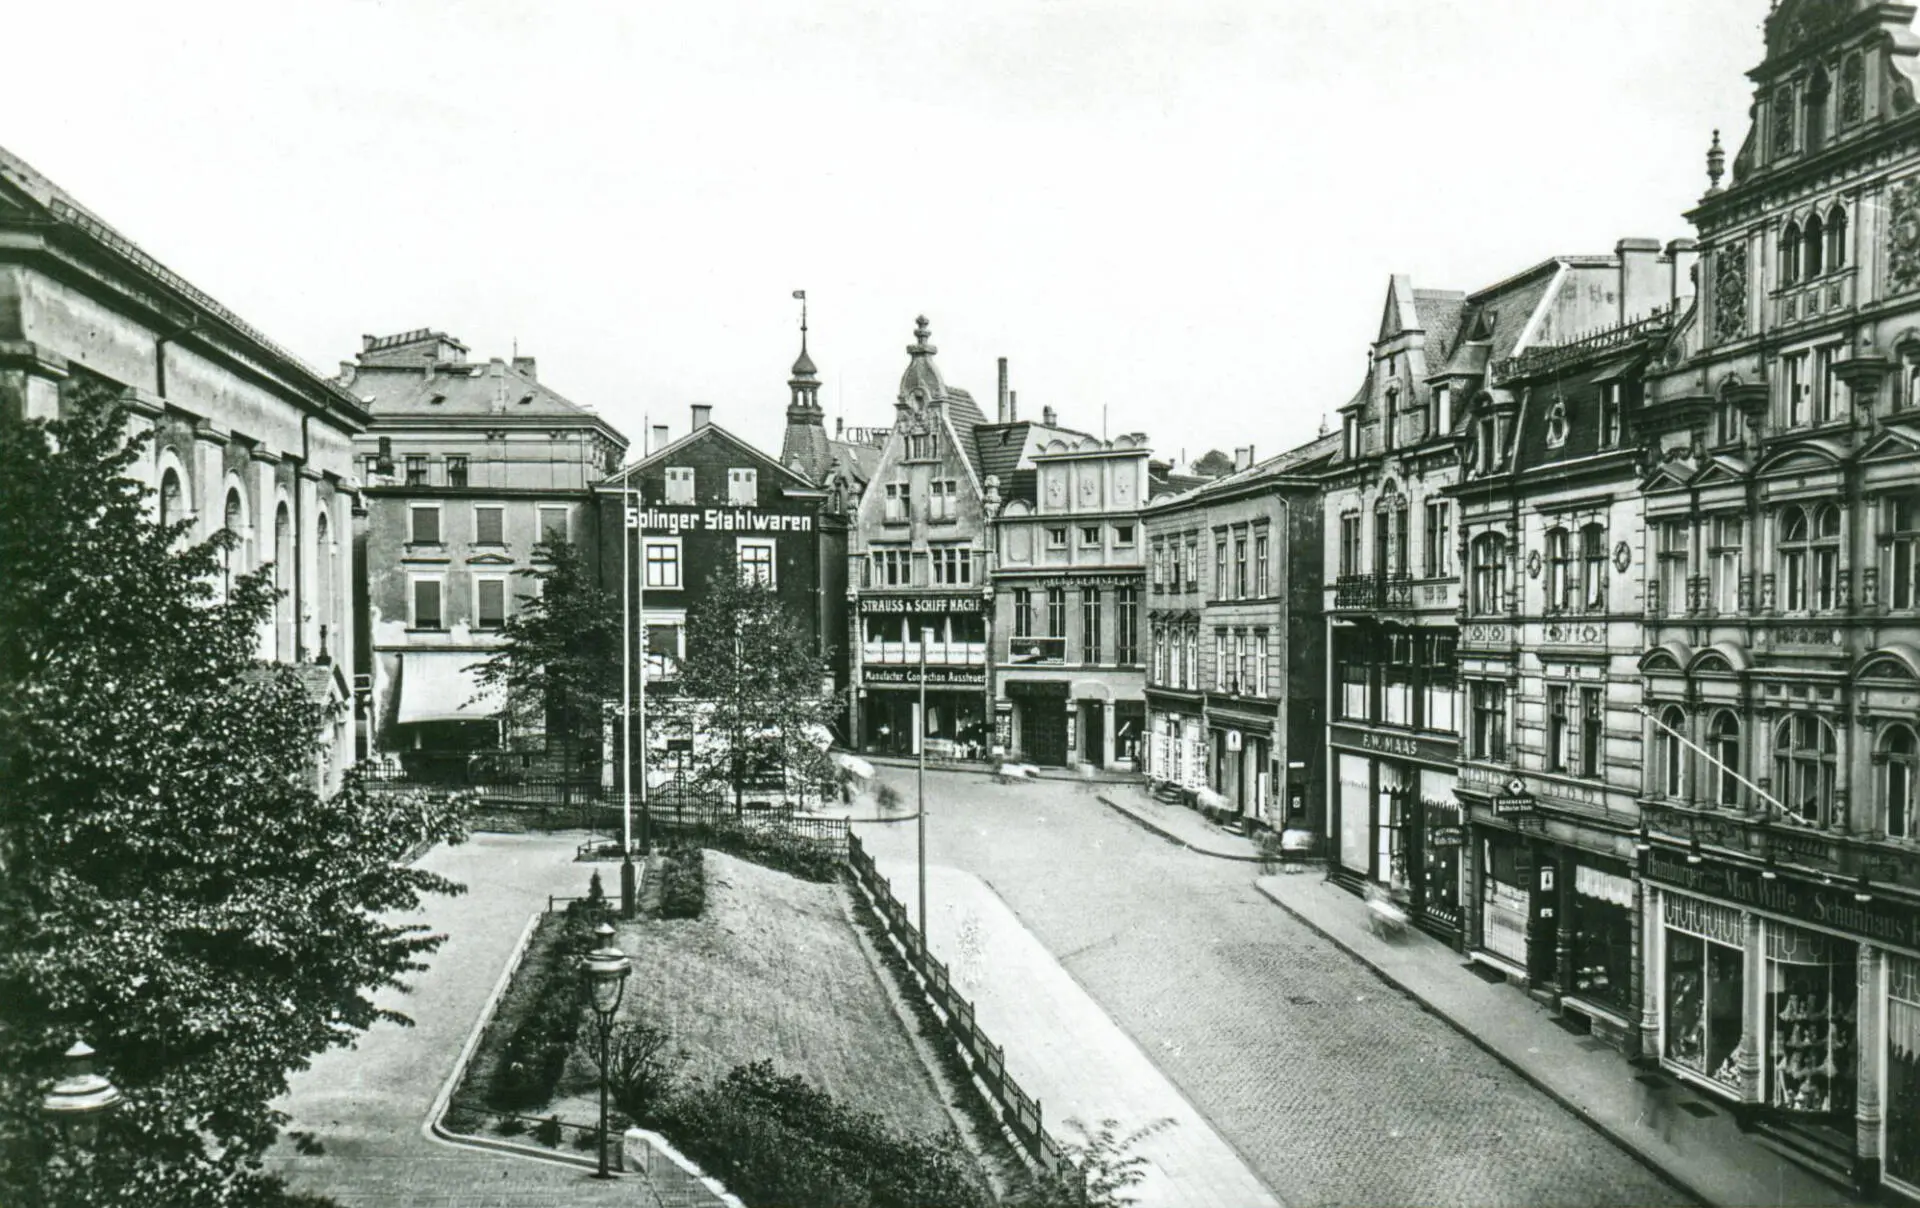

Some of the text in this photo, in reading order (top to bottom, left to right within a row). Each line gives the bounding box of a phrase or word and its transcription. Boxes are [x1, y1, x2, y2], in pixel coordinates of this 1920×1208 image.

[627, 508, 811, 534] Solinger Stahlwaren
[862, 599, 904, 612] STRAUSS
[906, 601, 911, 611] &
[914, 599, 948, 612] SCHIFF
[906, 671, 945, 682] Conection
[1384, 737, 1417, 755] MAAS
[1724, 868, 1754, 901] Max
